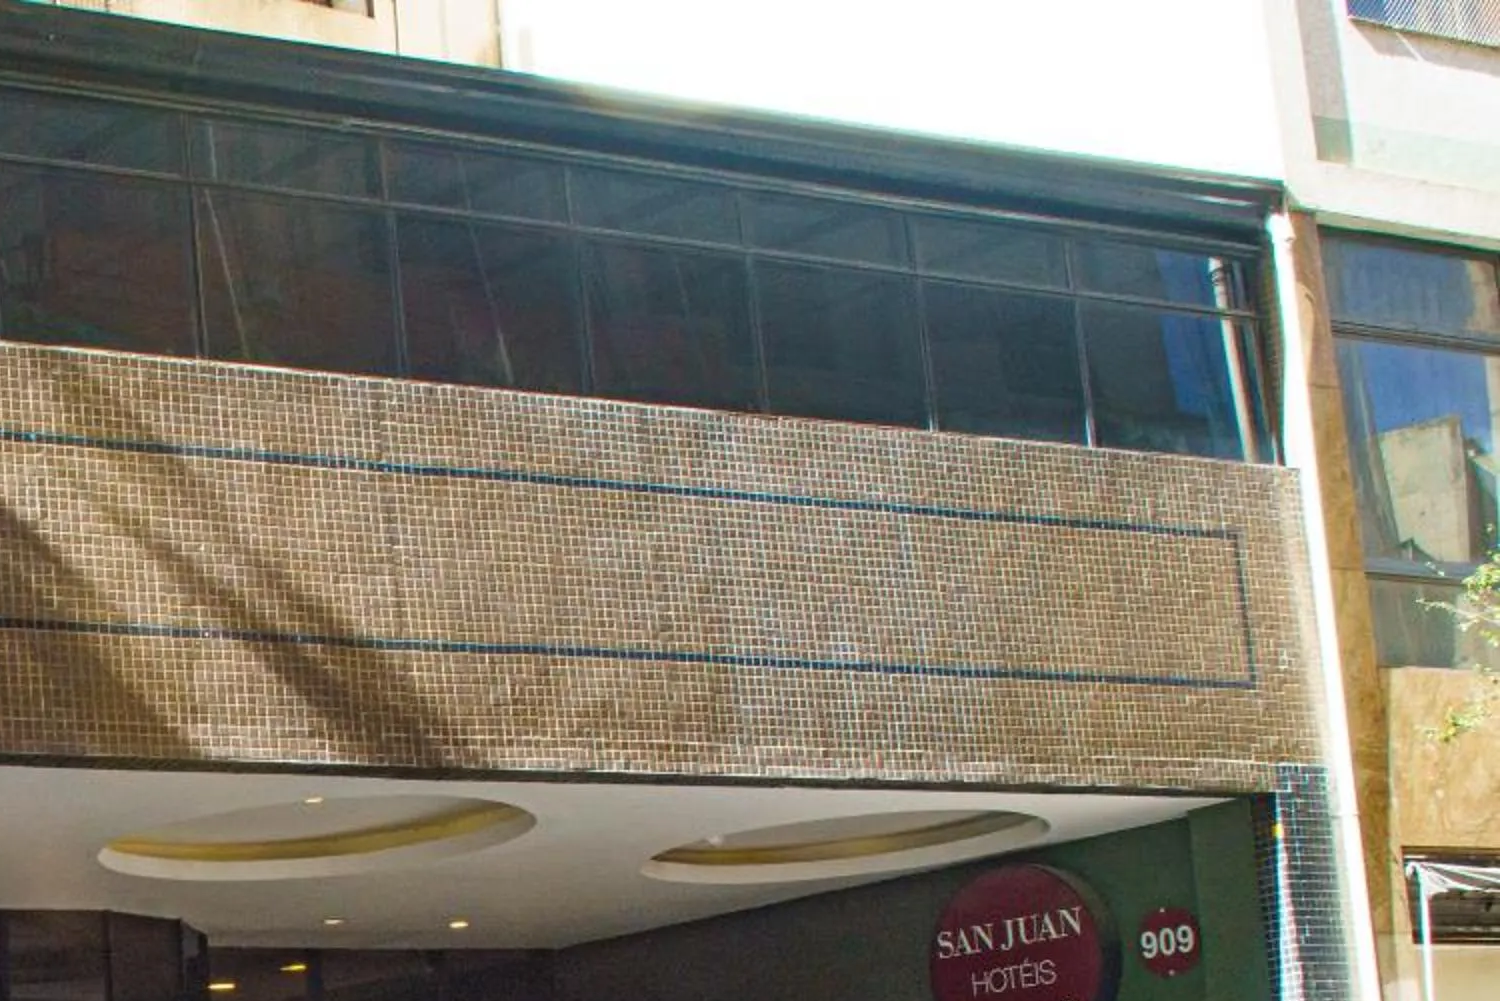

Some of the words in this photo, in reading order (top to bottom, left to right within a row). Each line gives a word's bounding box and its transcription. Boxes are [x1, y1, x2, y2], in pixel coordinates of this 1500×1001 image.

[936, 923, 995, 959] SAN
[1000, 906, 1083, 951] JUAN
[1140, 925, 1195, 959] 909
[971, 957, 1057, 997] HOTÉIS
